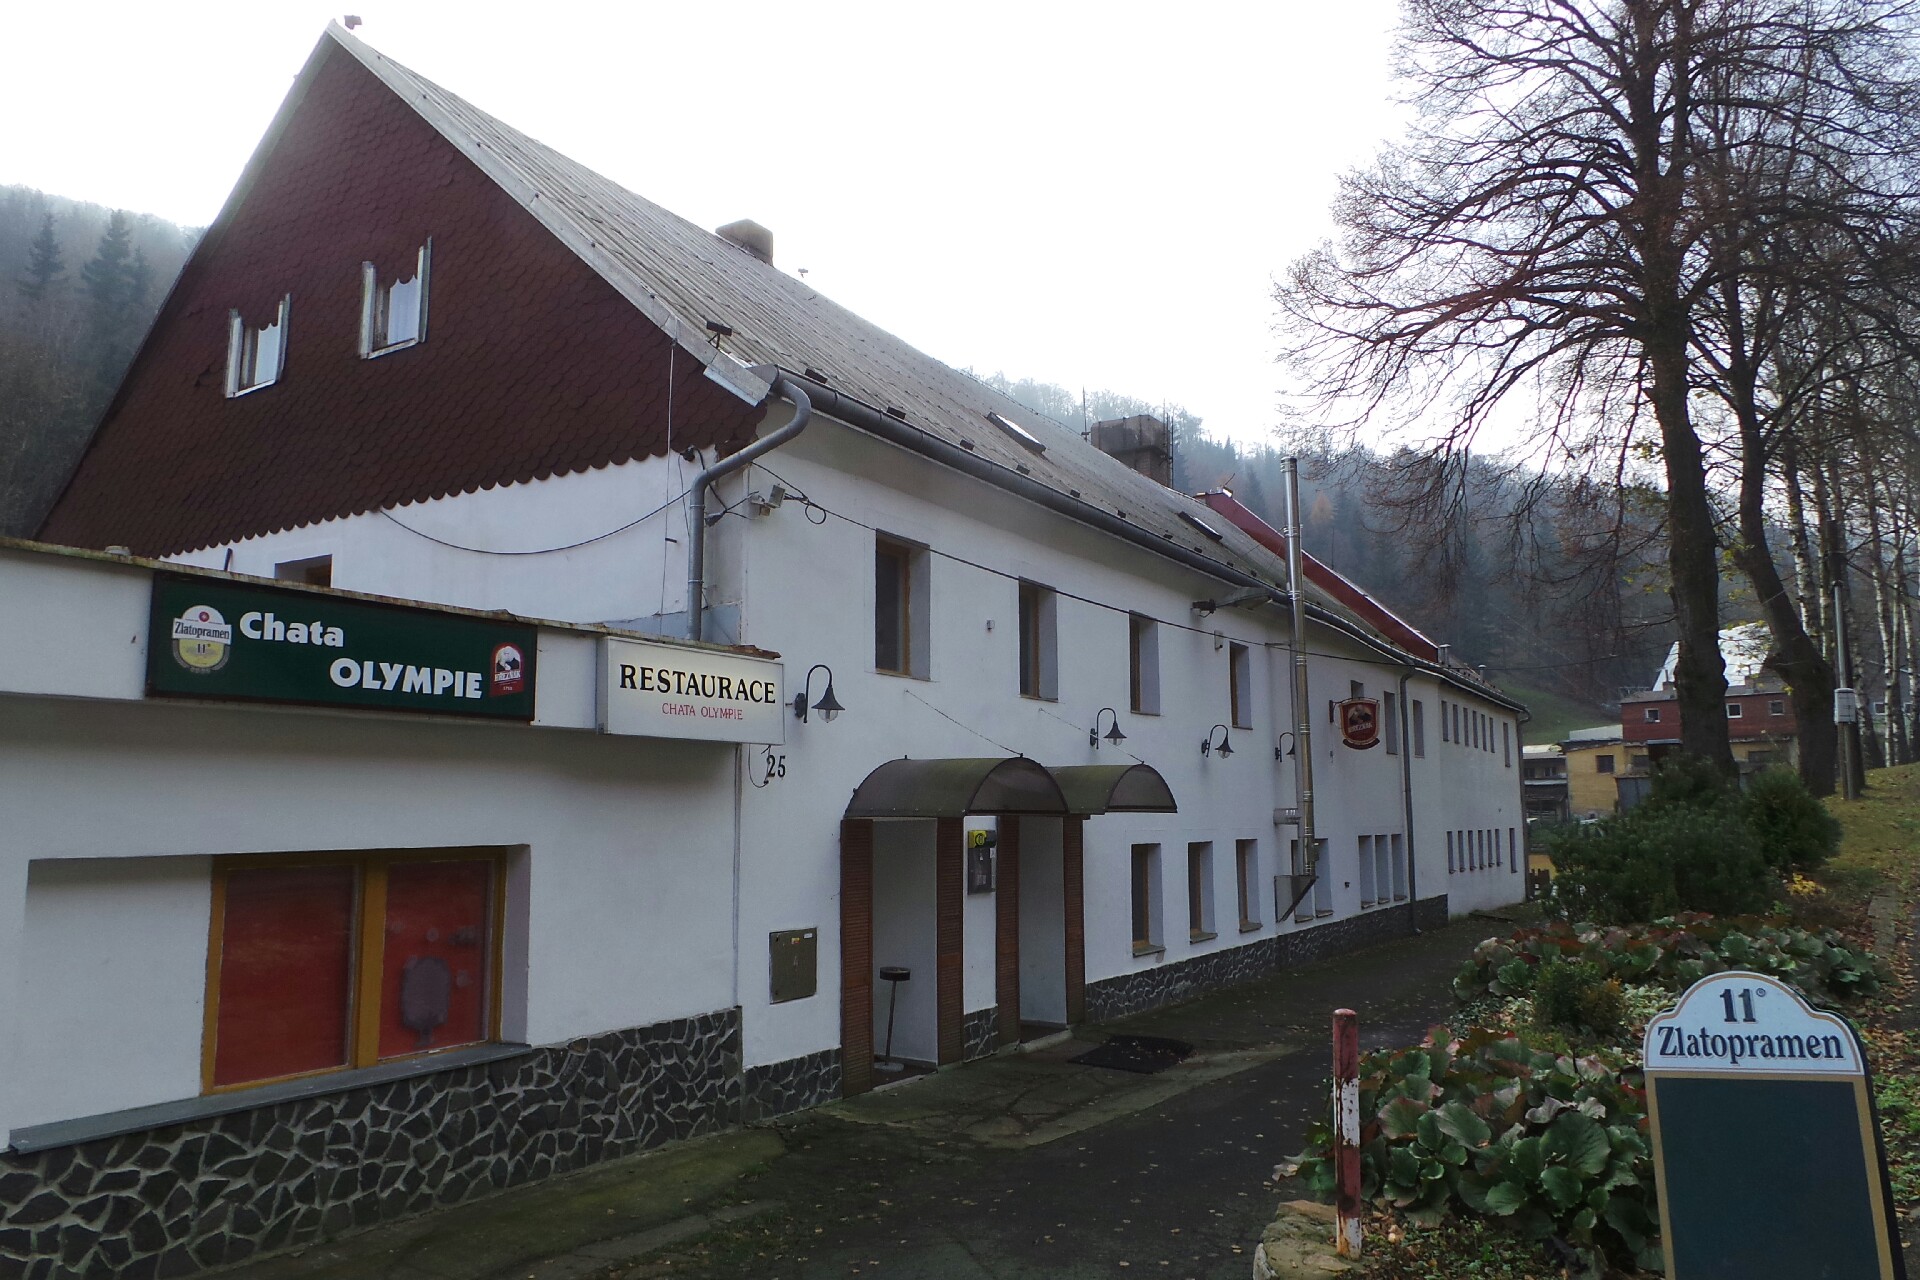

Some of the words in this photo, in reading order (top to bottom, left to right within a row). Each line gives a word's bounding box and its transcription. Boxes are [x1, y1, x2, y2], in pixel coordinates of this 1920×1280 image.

[174, 621, 230, 640] Zlatopramen
[239, 611, 344, 647] Chata
[330, 657, 483, 699] OLYMPIE
[619, 663, 776, 704] RESTAURACE
[661, 702, 696, 717] CHATA
[700, 705, 744, 720] OLYMPIE
[767, 754, 787, 778] 25
[1657, 1025, 1846, 1065] Zlatopramen
